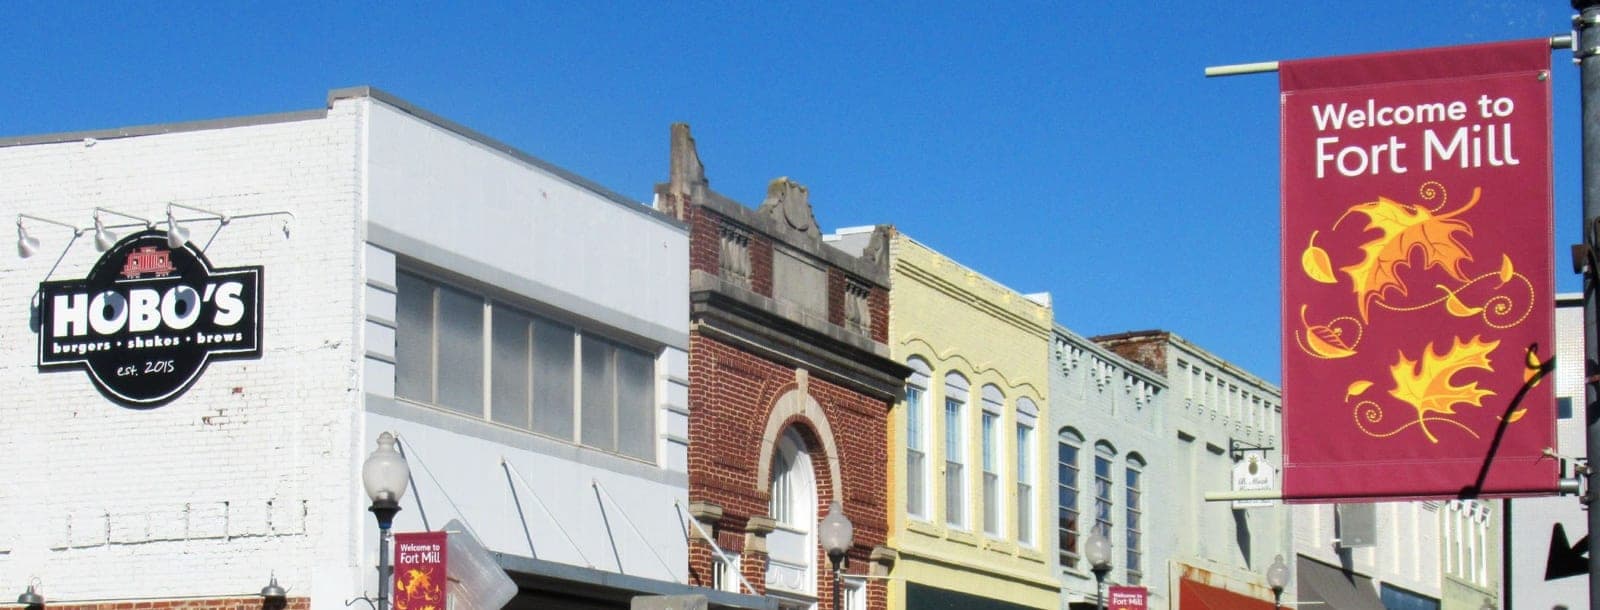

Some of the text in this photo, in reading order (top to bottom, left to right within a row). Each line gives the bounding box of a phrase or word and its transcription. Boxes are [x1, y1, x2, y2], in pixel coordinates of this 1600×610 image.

[1312, 94, 1514, 131] Welcome to
[1316, 123, 1520, 178] Fort Mill
[53, 282, 245, 337] HOBO'S
[53, 332, 242, 355] burgers shakes brews
[117, 360, 175, 377] est. 2015
[400, 543, 431, 551] Welcome
[400, 552, 440, 564] Fort Mill
